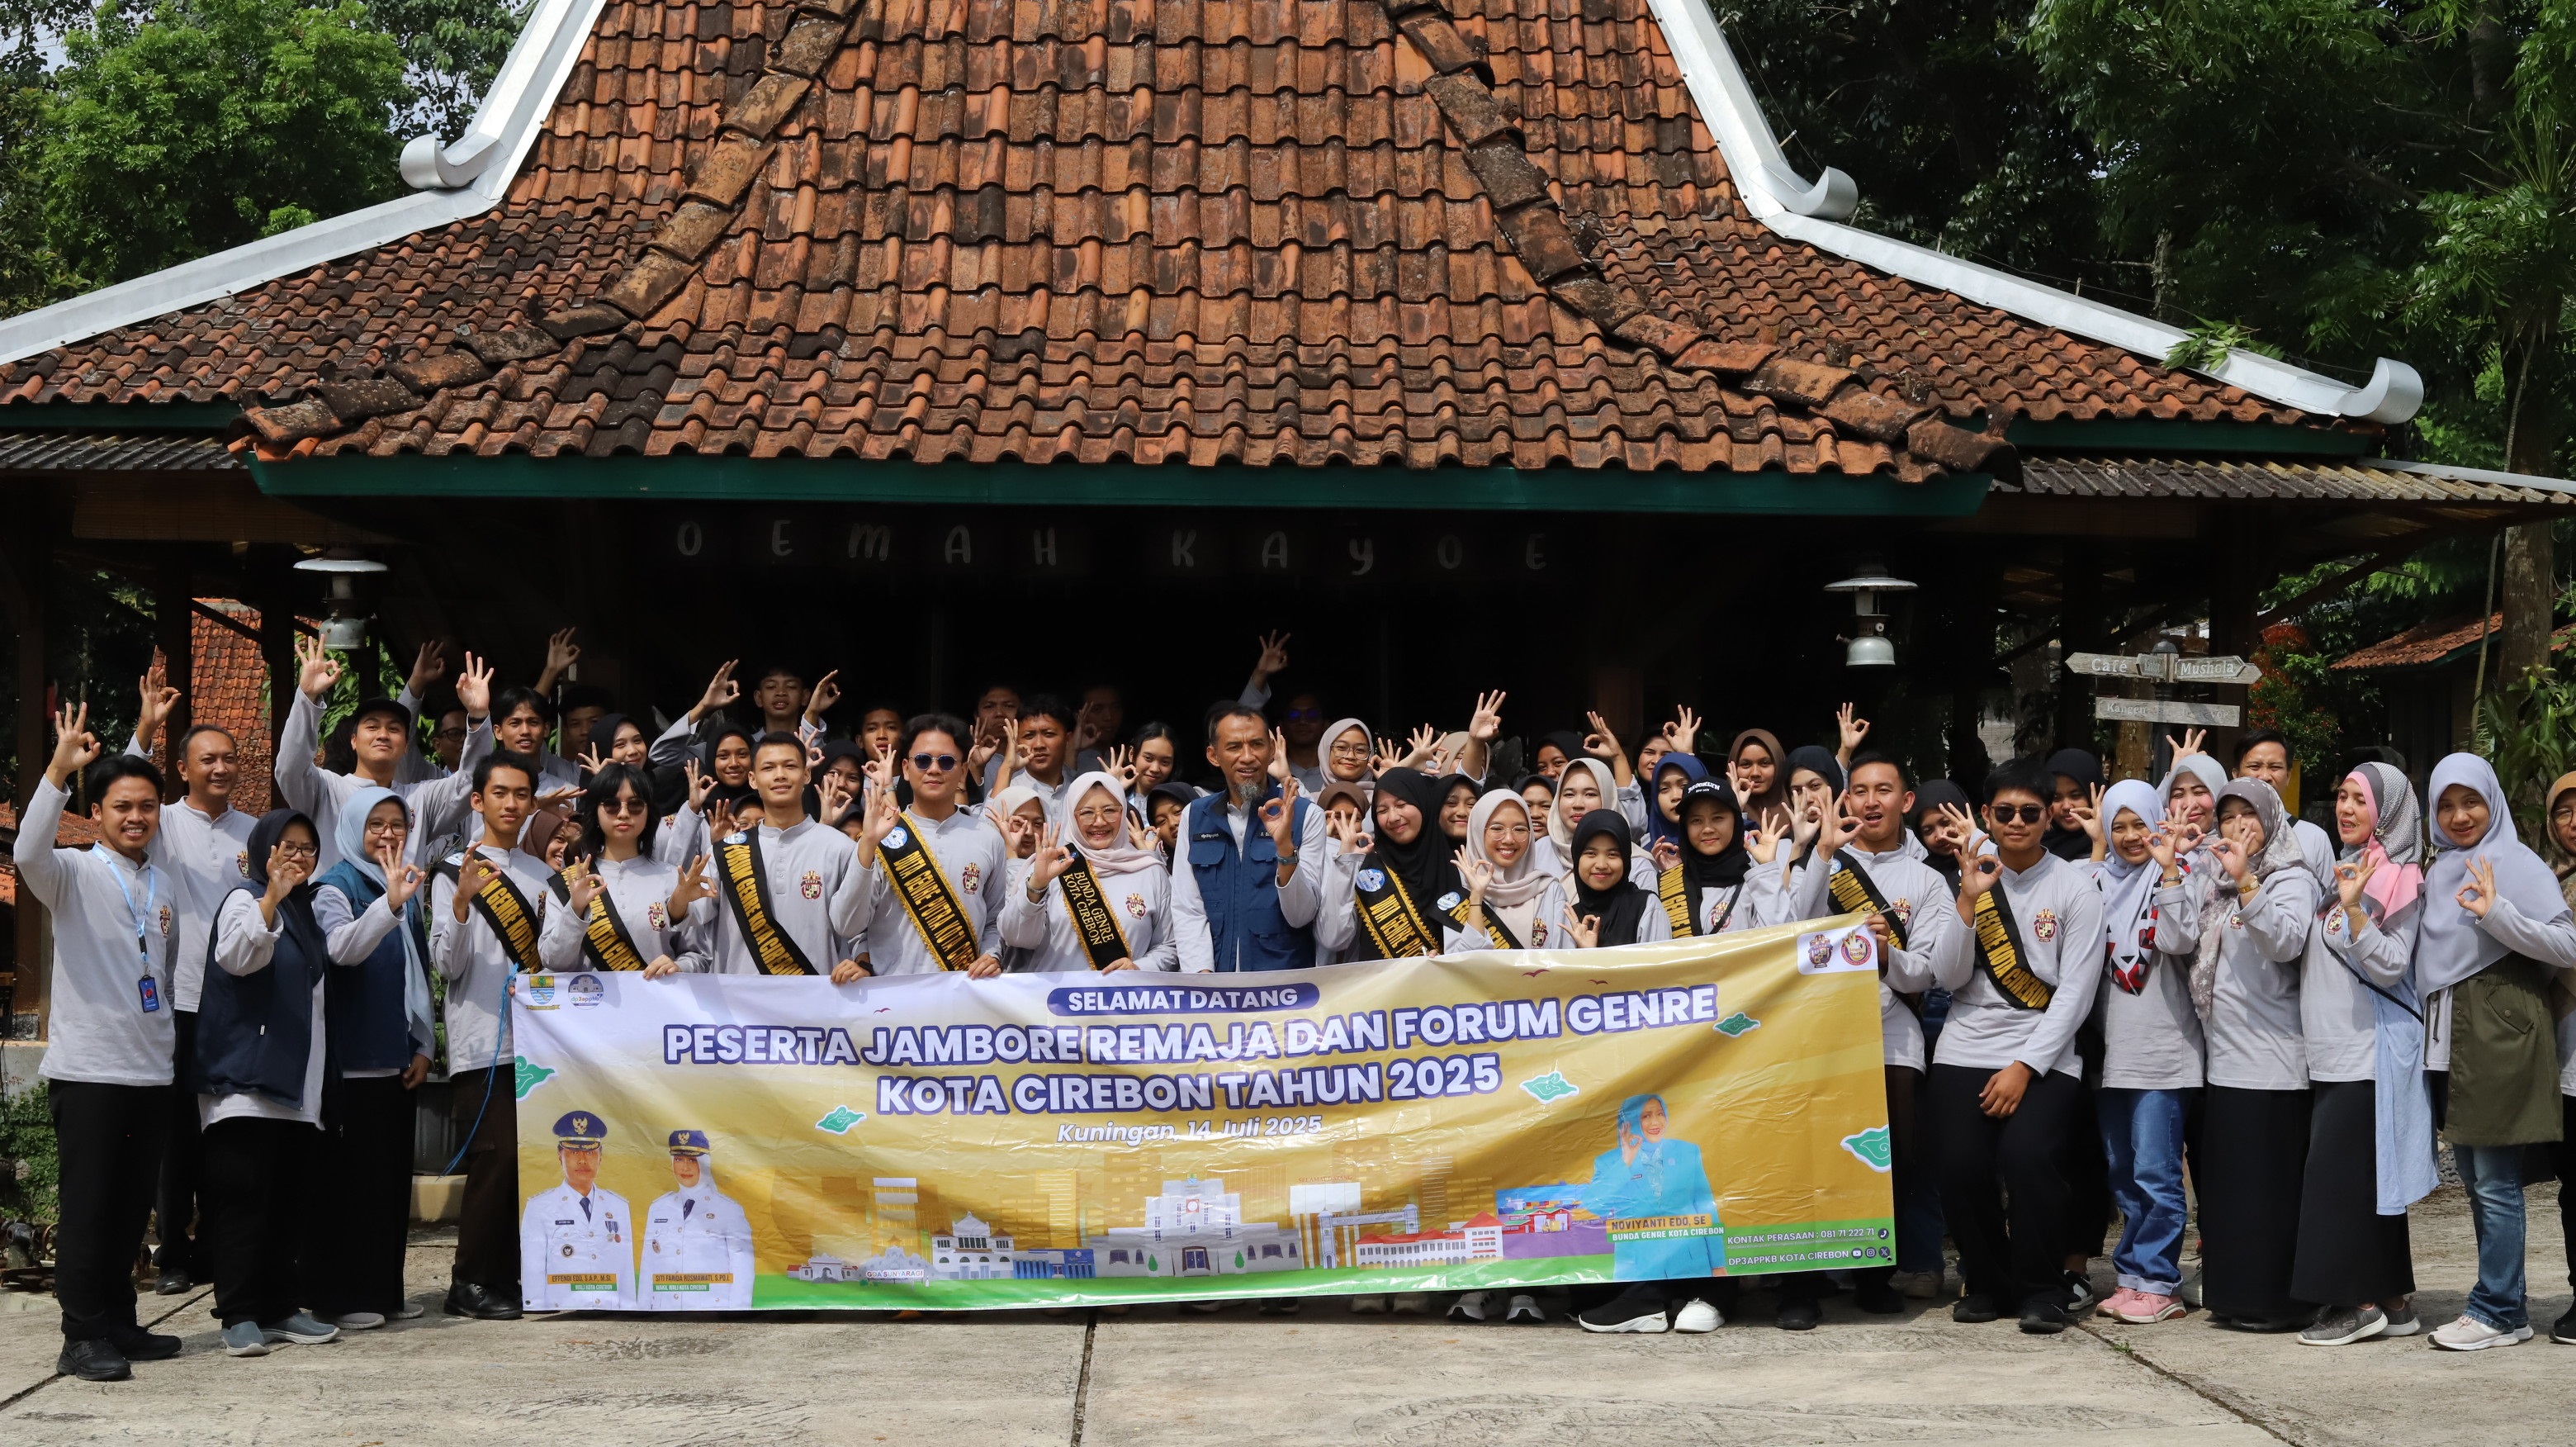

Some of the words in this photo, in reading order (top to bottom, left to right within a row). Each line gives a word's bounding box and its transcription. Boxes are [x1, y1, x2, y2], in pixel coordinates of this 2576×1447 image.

[2091, 658, 2128, 674] Café
[2181, 661, 2234, 676] Mushola
[2107, 703, 2147, 717] Kangen
[1688, 781, 1721, 794] BROOKLYN
[723, 844, 754, 884] FORUM
[893, 850, 927, 880] DUTA
[1660, 863, 1684, 899] FORUM
[736, 877, 761, 918] GENRE
[904, 870, 942, 906] GENRE
[1830, 868, 1869, 912] FORUM
[485, 887, 523, 928] GENRE
[505, 916, 534, 954] KOTA
[918, 894, 955, 932] PUTRA
[1063, 873, 1082, 901] KOTA
[1076, 901, 1103, 946] CIREBON
[1073, 871, 1098, 907] BUNDA
[1091, 908, 1115, 943] GENRE
[1369, 894, 1401, 923] DUTA
[1661, 894, 1691, 928] GENRE
[587, 917, 619, 953] KOTA
[748, 910, 776, 946] KOTA
[934, 919, 966, 953] KOTA
[1380, 913, 1416, 949] GENRE
[1976, 909, 2009, 951] GENRE
[1986, 941, 2017, 980] KOTA
[571, 994, 599, 1002] dp3appkb
[1068, 991, 1185, 1012] SELAMAT
[1191, 989, 1298, 1010] DATANG
[2001, 967, 2049, 1008] CIREBON
[665, 1026, 856, 1063] PESERTA
[864, 1026, 1080, 1063] JAMBORE
[1088, 1023, 1281, 1063] REMAJA
[1289, 1013, 1384, 1056] DAN
[1395, 1000, 1560, 1048] FORUM
[1569, 987, 1717, 1032] GENRE
[880, 1076, 1007, 1113] KOTA
[1014, 1074, 1211, 1112] CIREBON
[1219, 1061, 1385, 1108] TAHUN
[1390, 1056, 1500, 1097] 2025
[1057, 1122, 1181, 1146] Kuningan,
[1186, 1122, 1210, 1140] 14
[1217, 1118, 1260, 1138] Juli
[1266, 1116, 1323, 1136] 2025
[1612, 1218, 1666, 1231] NOVIYANTI
[1669, 1217, 1691, 1228] EDO,
[1693, 1215, 1706, 1226] SE
[1612, 1231, 1640, 1241] BUNDA
[1641, 1231, 1667, 1240] GENRE
[1669, 1228, 1689, 1238] KOTA
[1690, 1226, 1725, 1237] CIREBON
[1727, 1234, 1765, 1245] KONTAK
[1767, 1231, 1815, 1242] PERASAAN
[1821, 1229, 1836, 1239] 081
[1838, 1229, 1847, 1238] 71
[1849, 1228, 1864, 1237] 222
[1865, 1227, 1874, 1236] 71
[883, 1269, 924, 1279] SUNYARAGI
[1728, 1254, 1778, 1266] DP3APPKB
[1779, 1252, 1806, 1262] KOTA
[1807, 1250, 1849, 1261] CIREBON
[552, 1274, 571, 1283] EFFENDI
[655, 1274, 664, 1283] SITI
[665, 1274, 683, 1283] FARIDA
